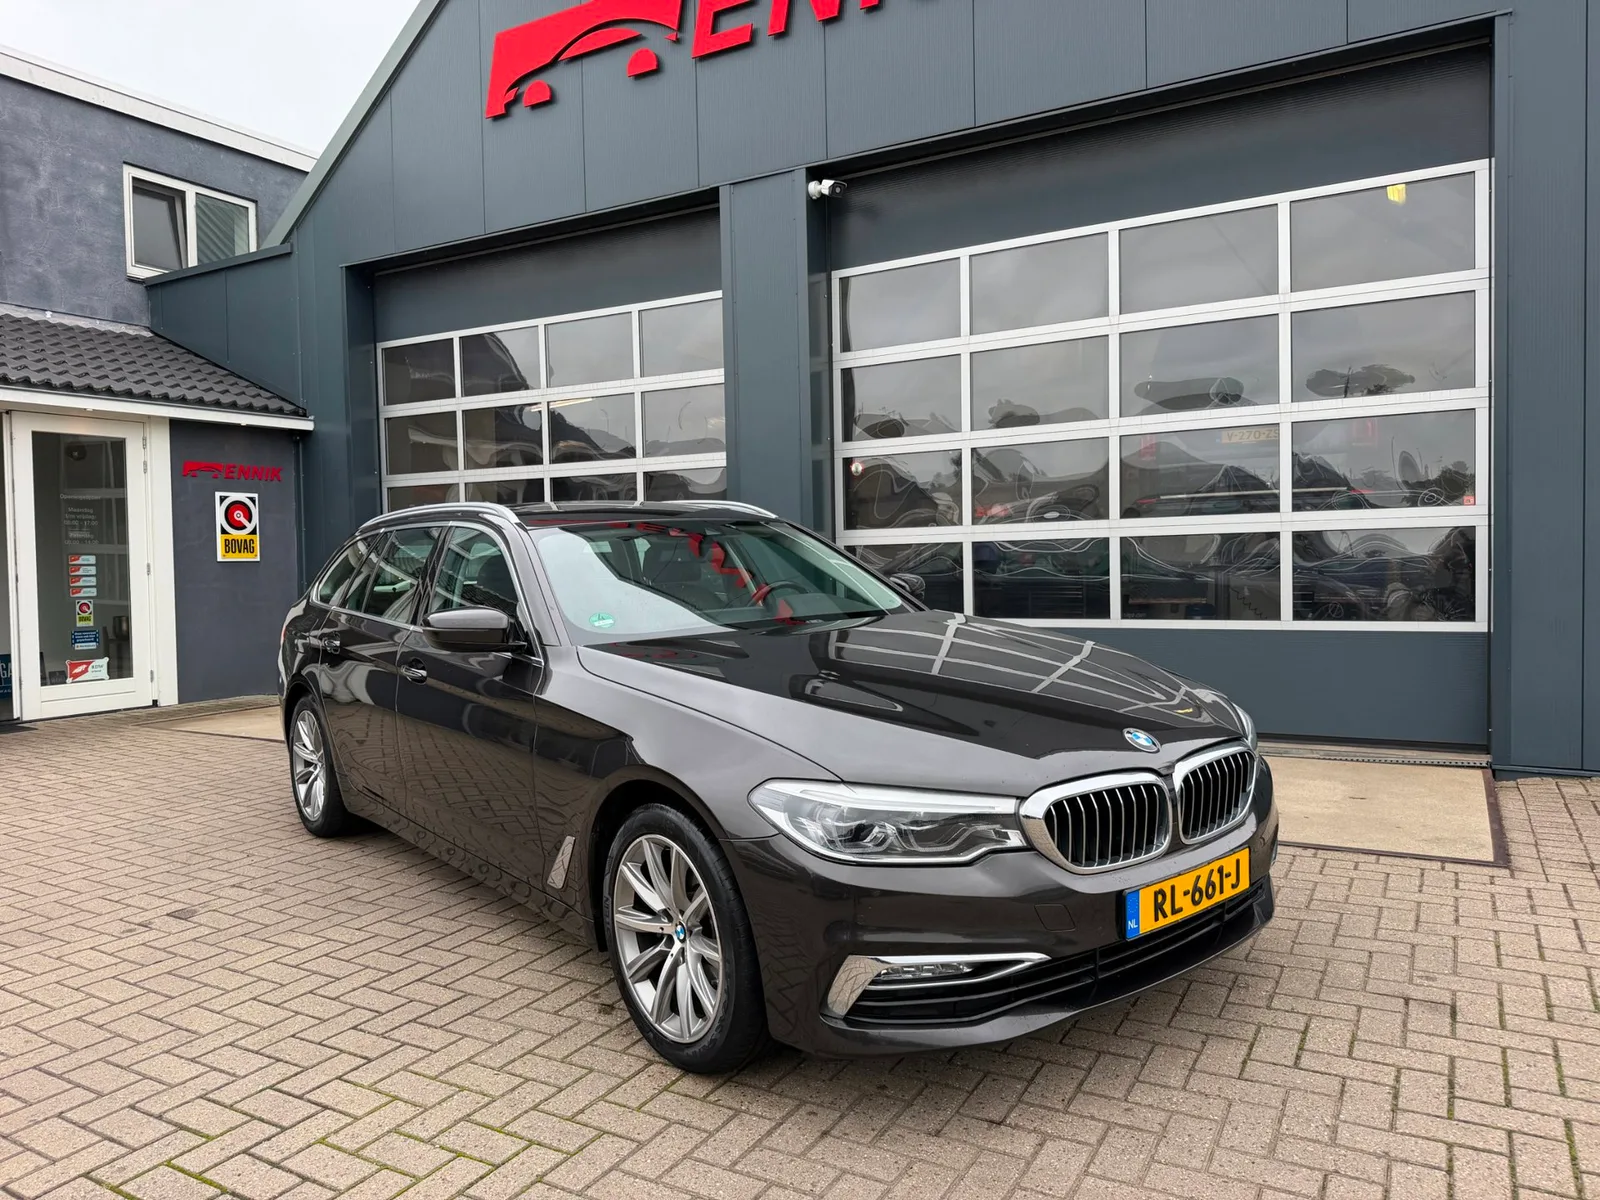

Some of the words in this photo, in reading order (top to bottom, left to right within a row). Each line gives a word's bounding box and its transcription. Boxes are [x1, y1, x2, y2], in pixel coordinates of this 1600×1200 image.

[224, 538, 255, 554] BOVAG
[1153, 858, 1241, 922] RL-661-J
[1127, 919, 1138, 930] NL
